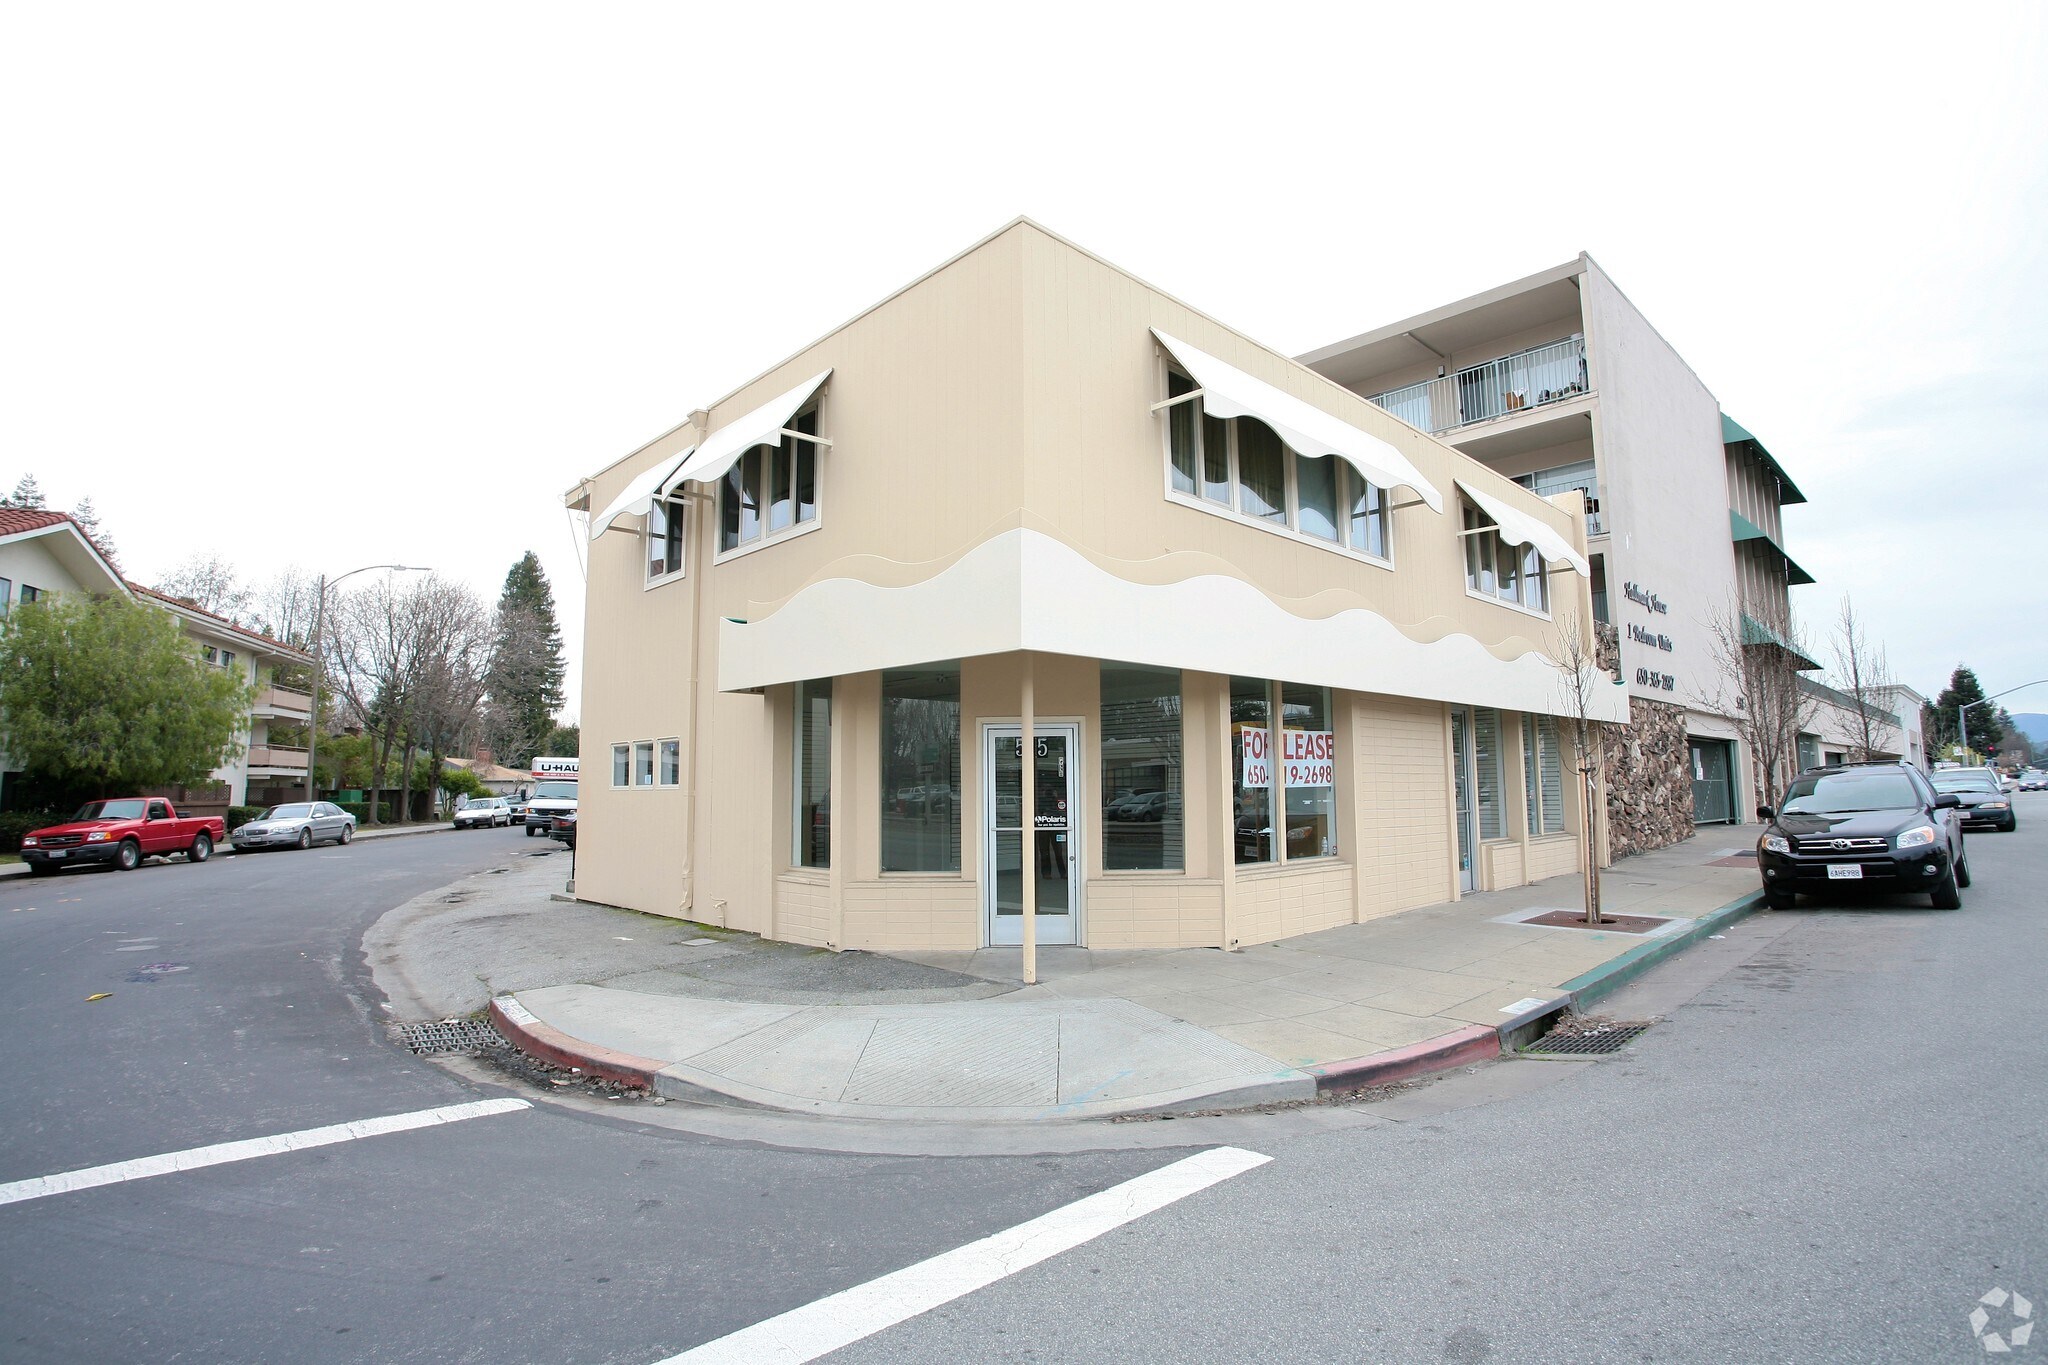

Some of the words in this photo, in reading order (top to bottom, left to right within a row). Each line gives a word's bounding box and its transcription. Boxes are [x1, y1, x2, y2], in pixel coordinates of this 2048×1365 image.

[1015, 738, 1048, 757] 55
[1283, 733, 1333, 760] LEASE
[1041, 815, 1066, 823] Polaris
